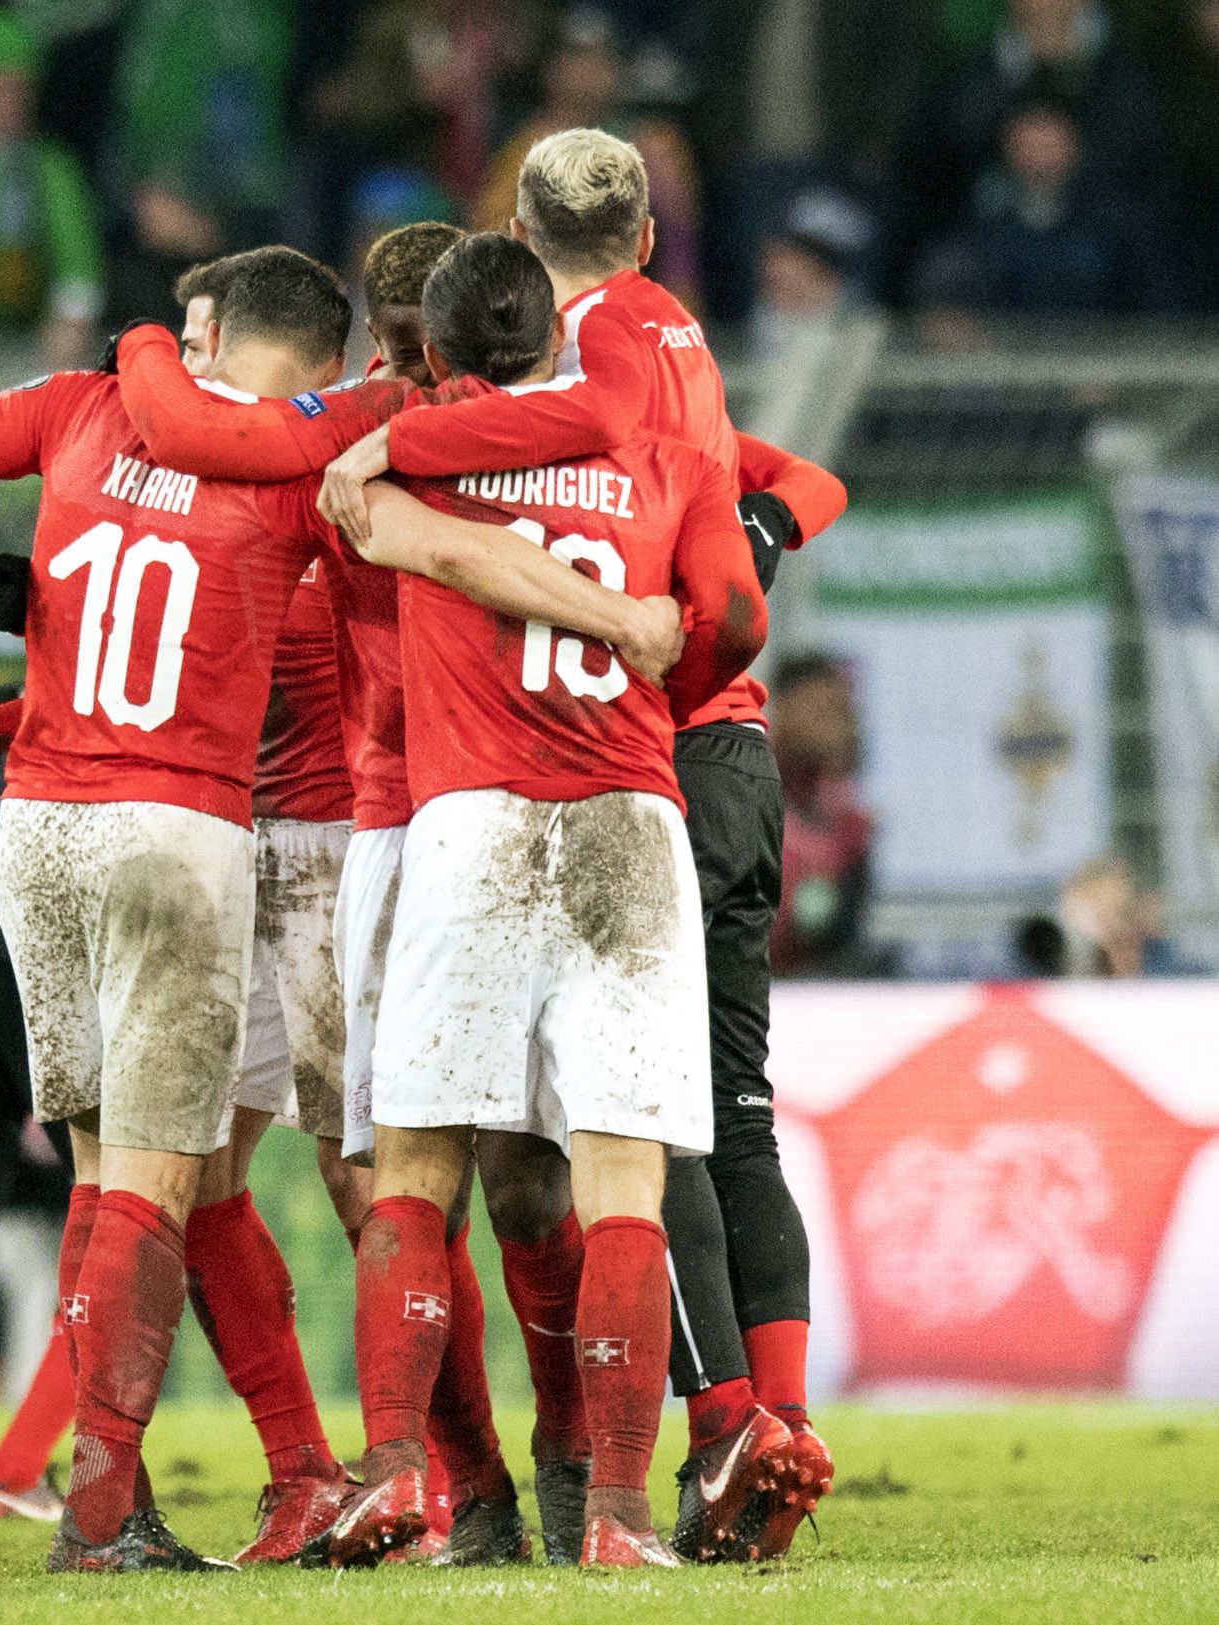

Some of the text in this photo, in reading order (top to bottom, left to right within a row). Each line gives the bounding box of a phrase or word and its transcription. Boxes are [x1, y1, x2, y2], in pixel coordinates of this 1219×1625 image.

[101, 452, 199, 515] XHAKA
[458, 466, 634, 519] RODRIGUEZ
[48, 520, 200, 733] 10
